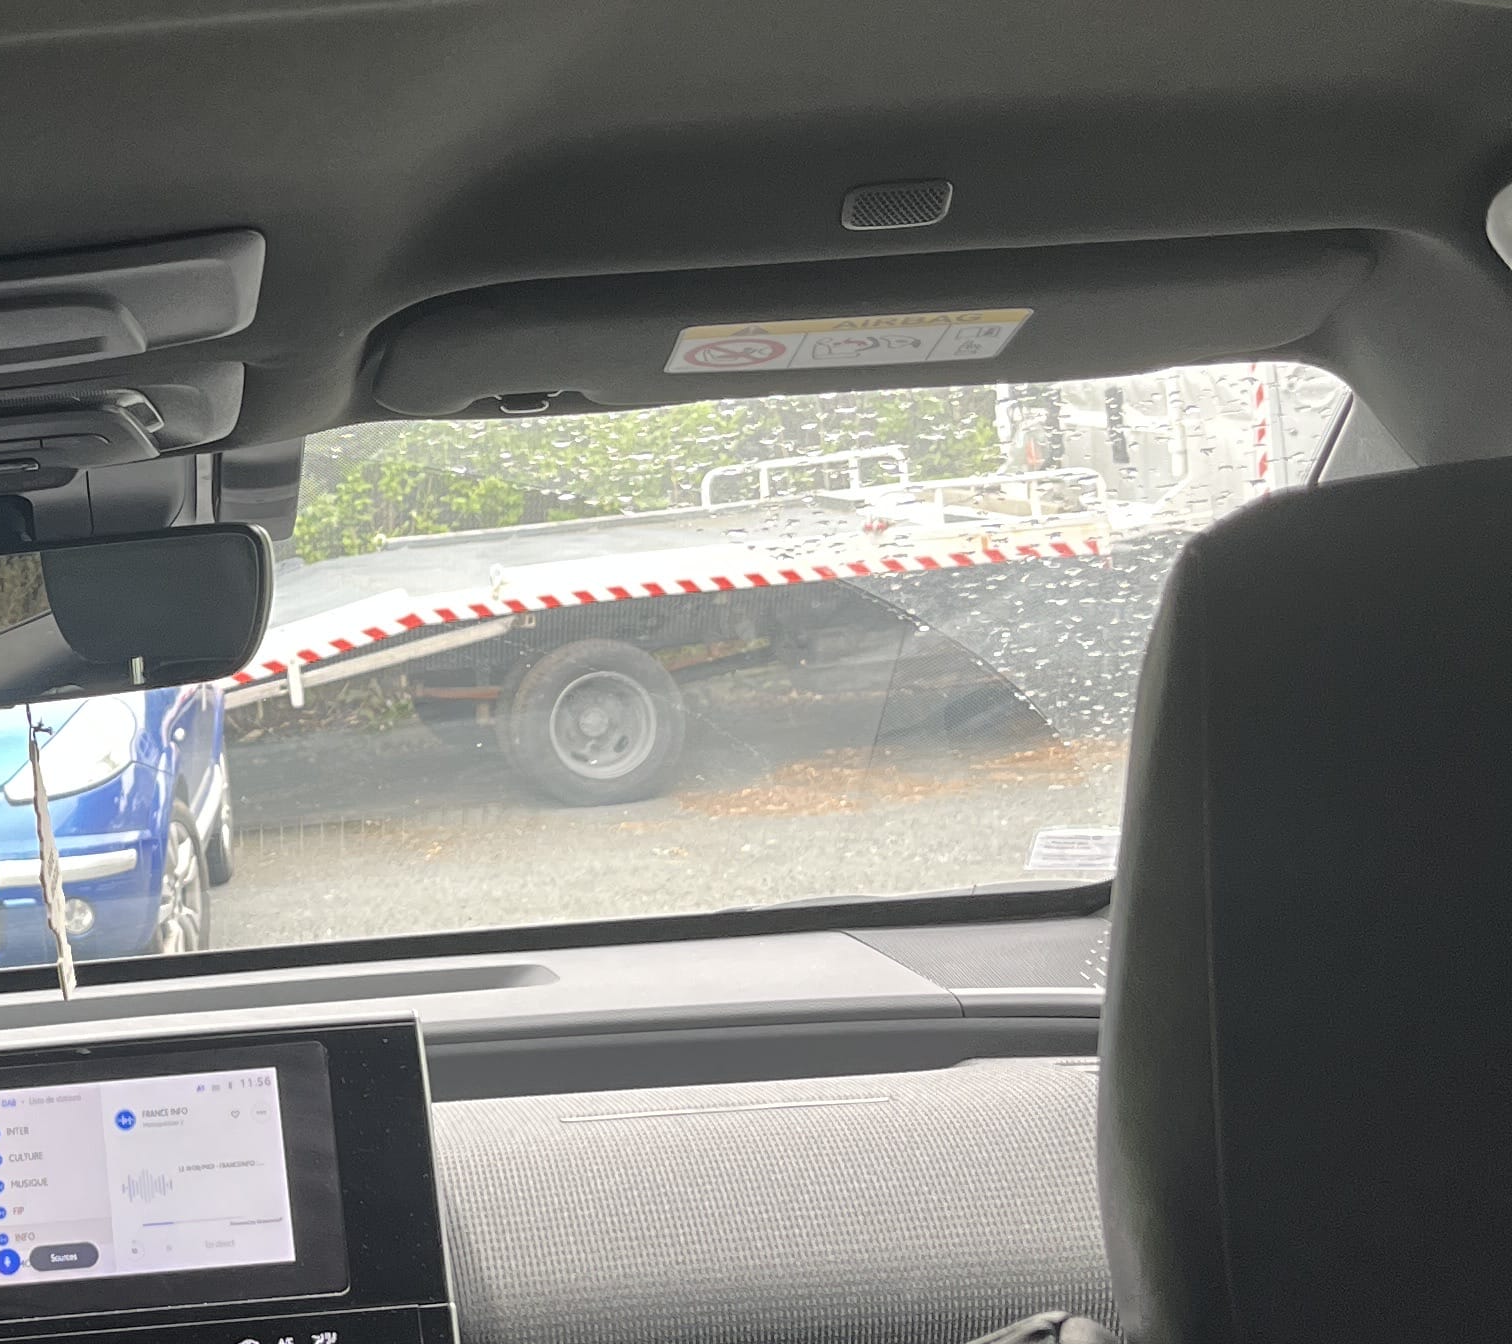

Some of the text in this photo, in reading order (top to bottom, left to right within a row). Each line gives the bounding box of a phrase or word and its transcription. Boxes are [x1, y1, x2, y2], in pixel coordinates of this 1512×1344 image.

[832, 313, 986, 330] AIRBAG
[240, 1076, 272, 1089] 11:56
[6, 1126, 29, 1136] INTER
[8, 1151, 43, 1163] CULTURE
[10, 1176, 49, 1189] MUSIQUE
